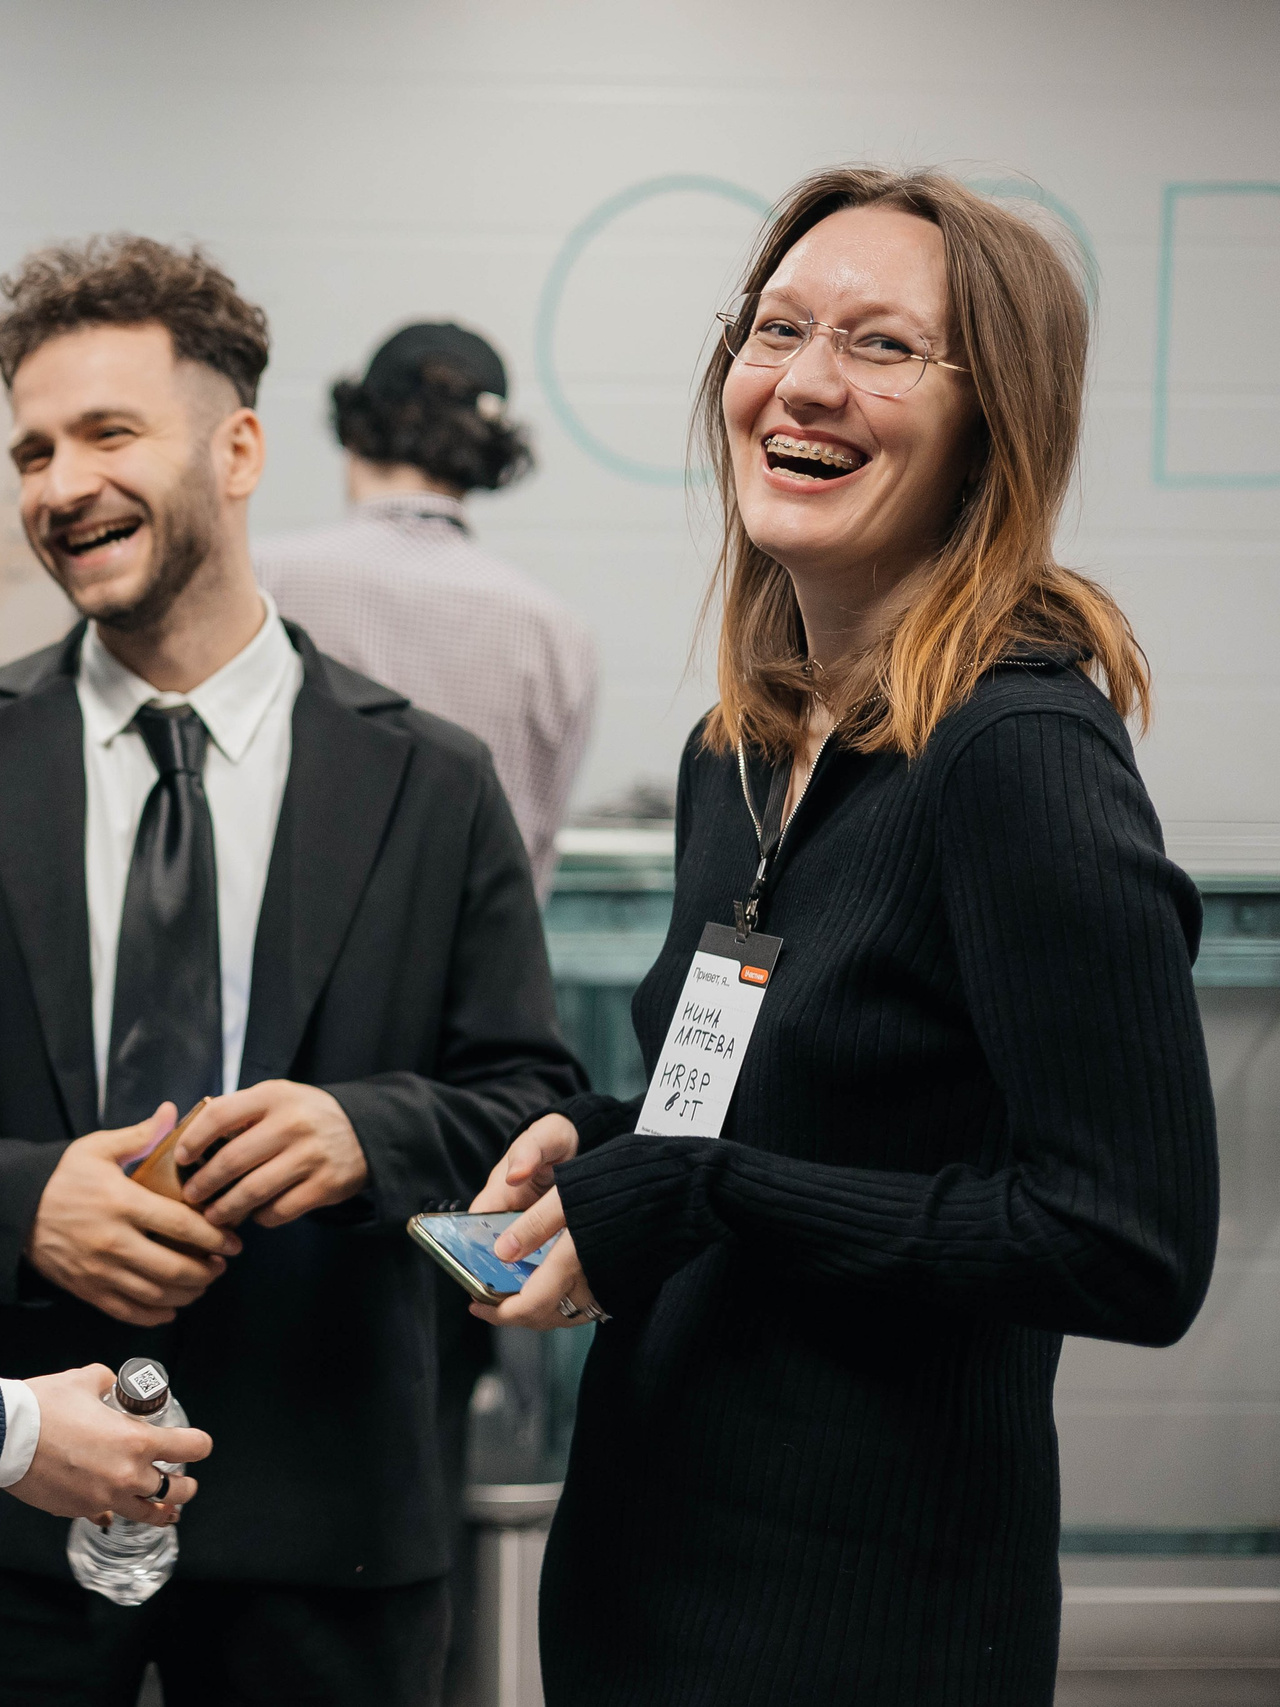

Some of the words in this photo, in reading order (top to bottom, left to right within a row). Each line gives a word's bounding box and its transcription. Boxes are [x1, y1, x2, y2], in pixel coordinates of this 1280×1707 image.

[693, 966, 720, 985] Привет,
[682, 1001, 722, 1029] НИНА
[673, 1025, 735, 1060] ЛАПТЕВА
